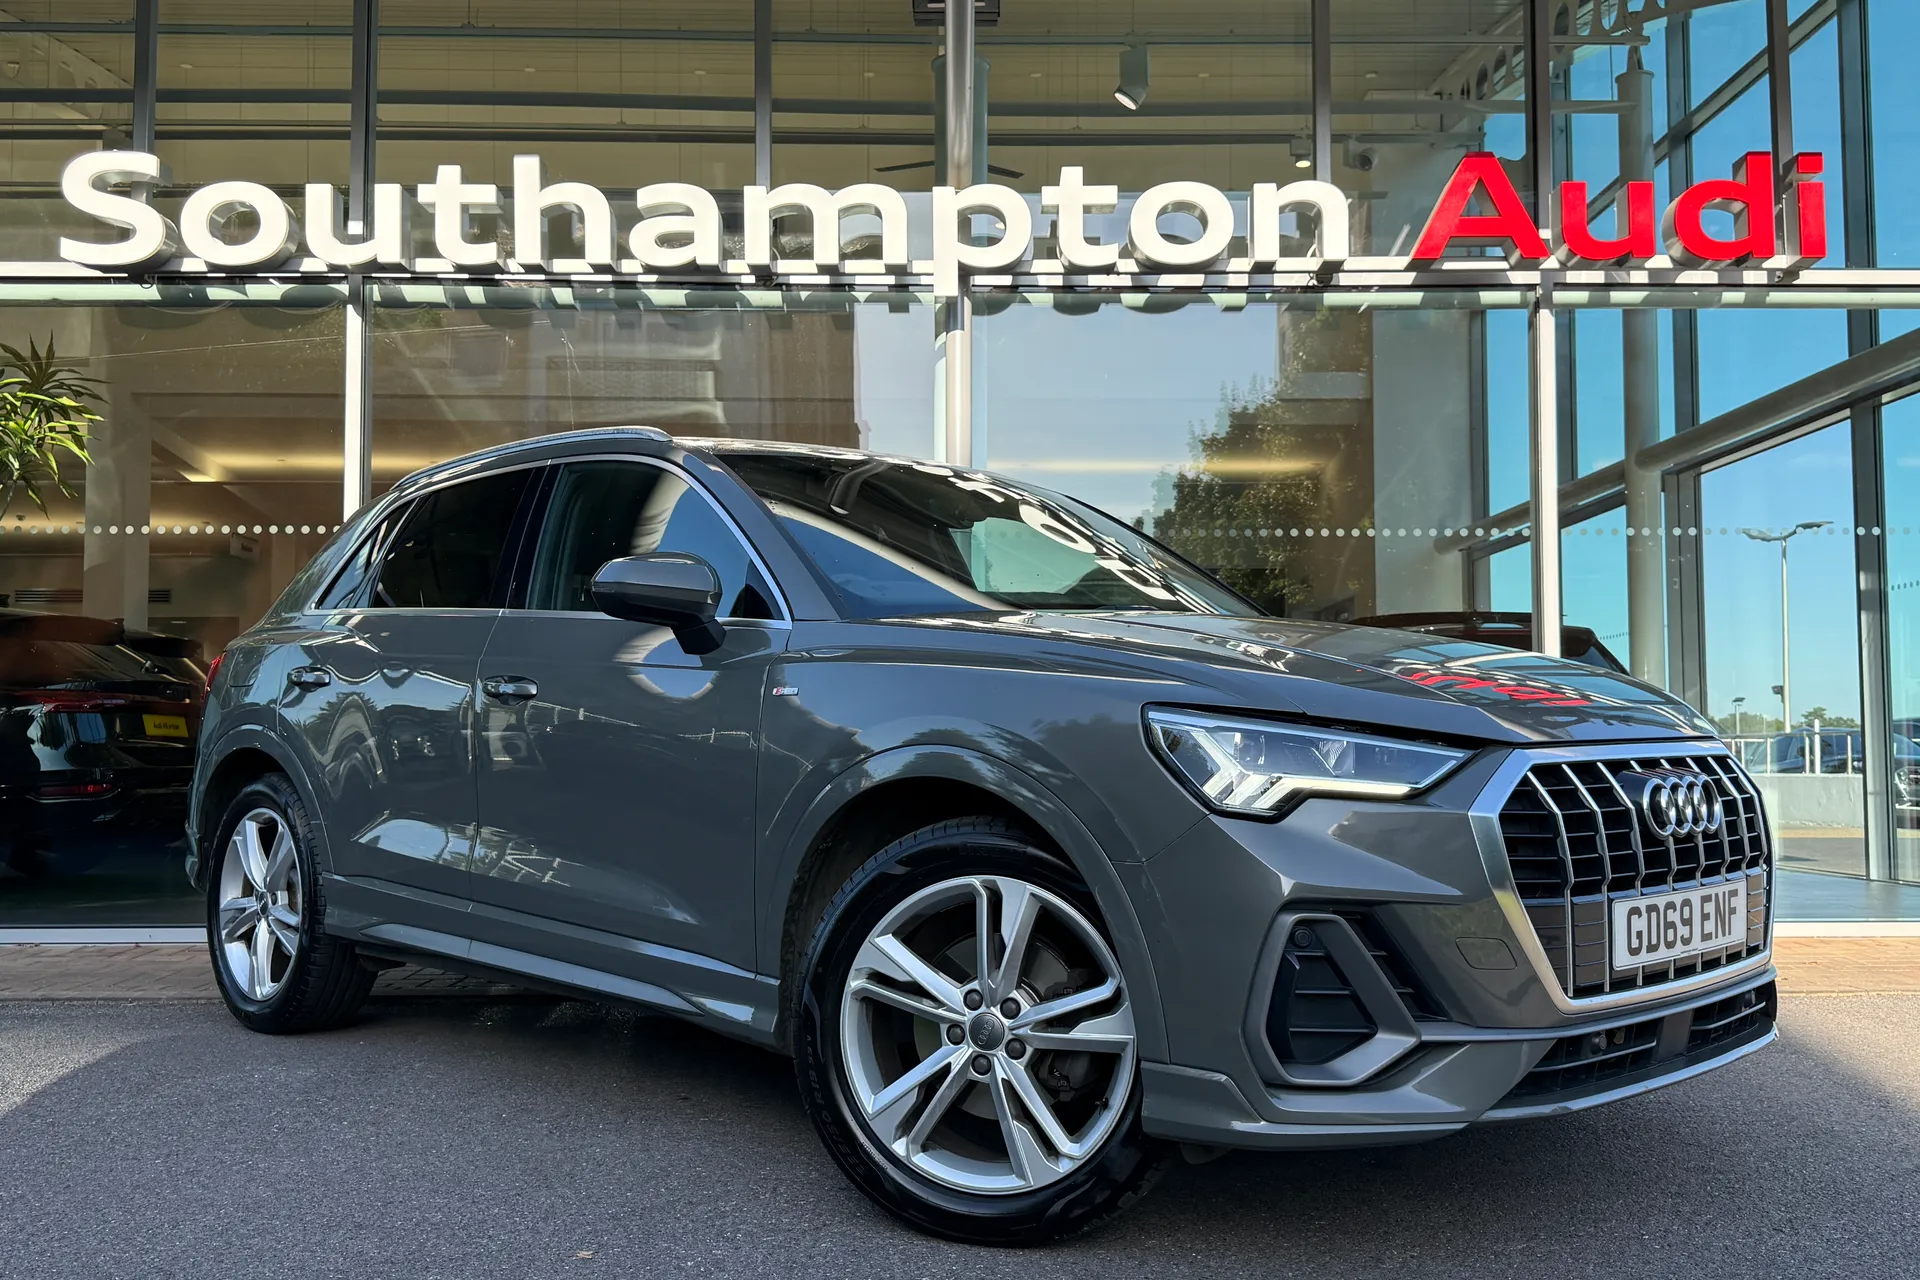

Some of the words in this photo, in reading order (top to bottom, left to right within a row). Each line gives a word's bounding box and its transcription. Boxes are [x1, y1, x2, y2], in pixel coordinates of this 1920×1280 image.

[59, 149, 1351, 298] Southampton
[1410, 150, 1828, 263] Audi
[1626, 897, 1694, 957] GD69
[1700, 888, 1740, 943] ENF
